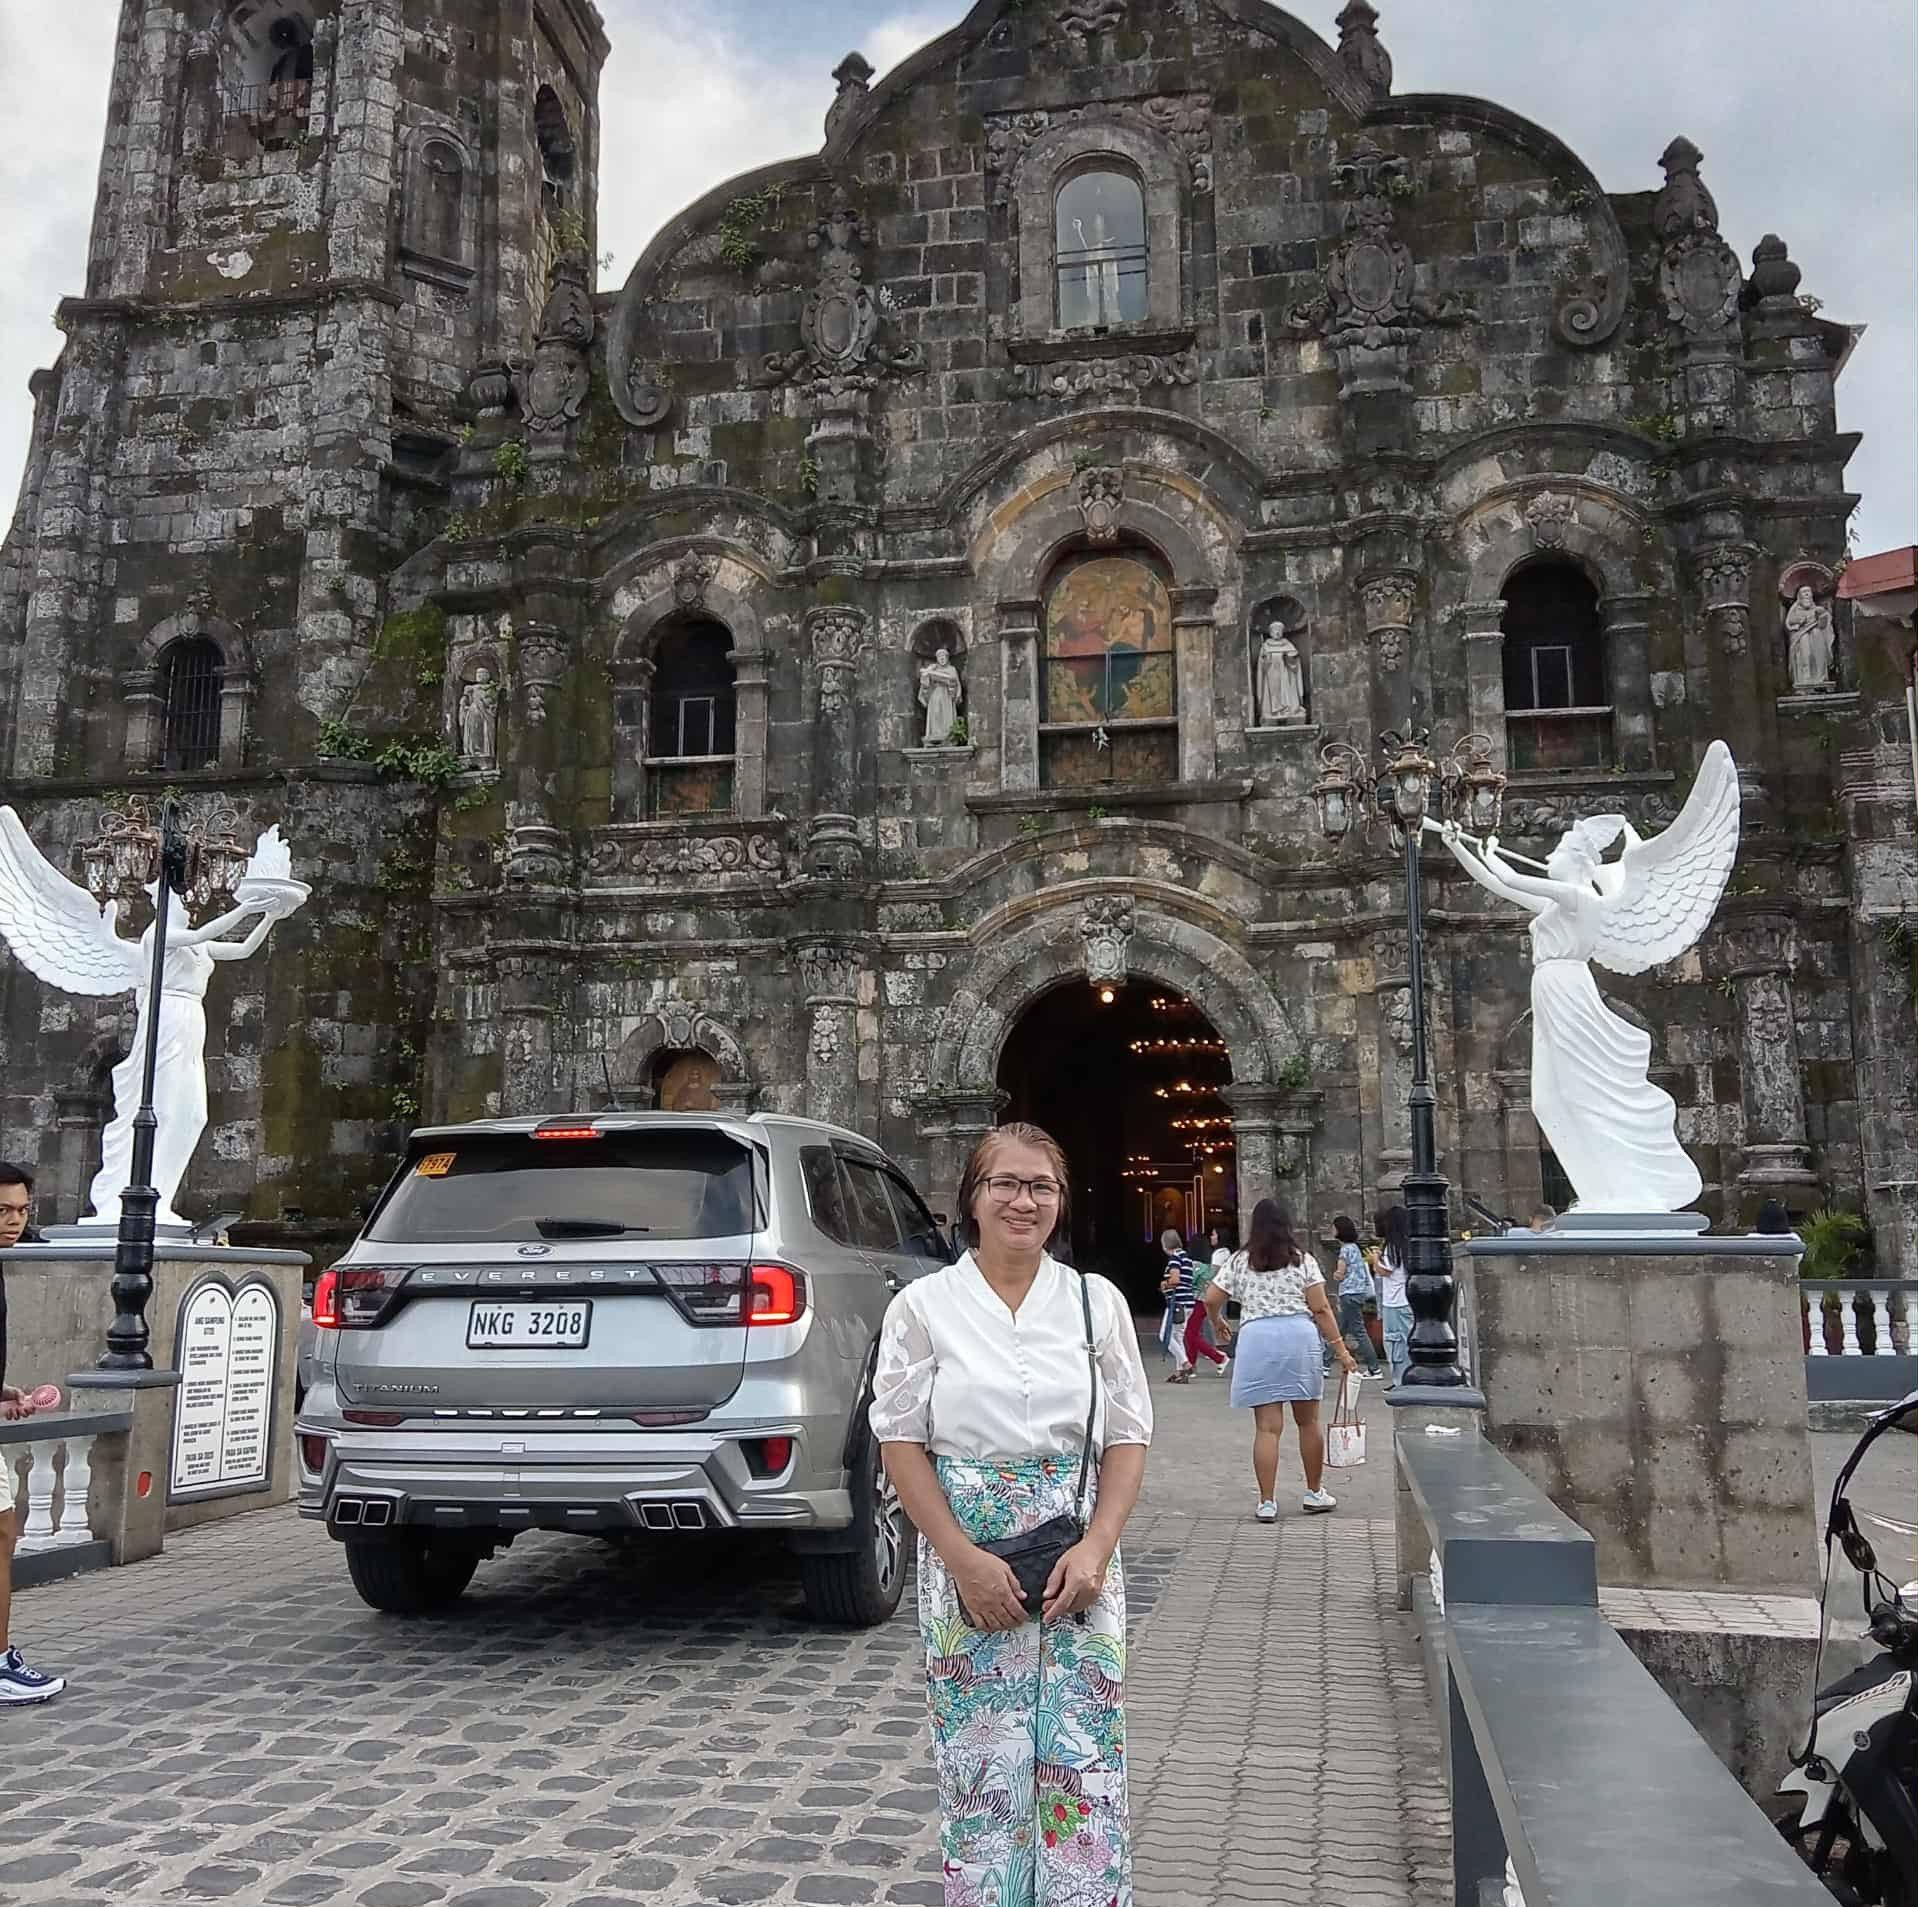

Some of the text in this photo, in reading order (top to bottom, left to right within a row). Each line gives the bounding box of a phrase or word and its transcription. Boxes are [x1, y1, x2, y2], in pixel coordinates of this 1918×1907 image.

[421, 1270, 640, 1281] EVEREST
[473, 1311, 582, 1335] NKG 3208
[352, 1383, 440, 1393] TITANIUM
